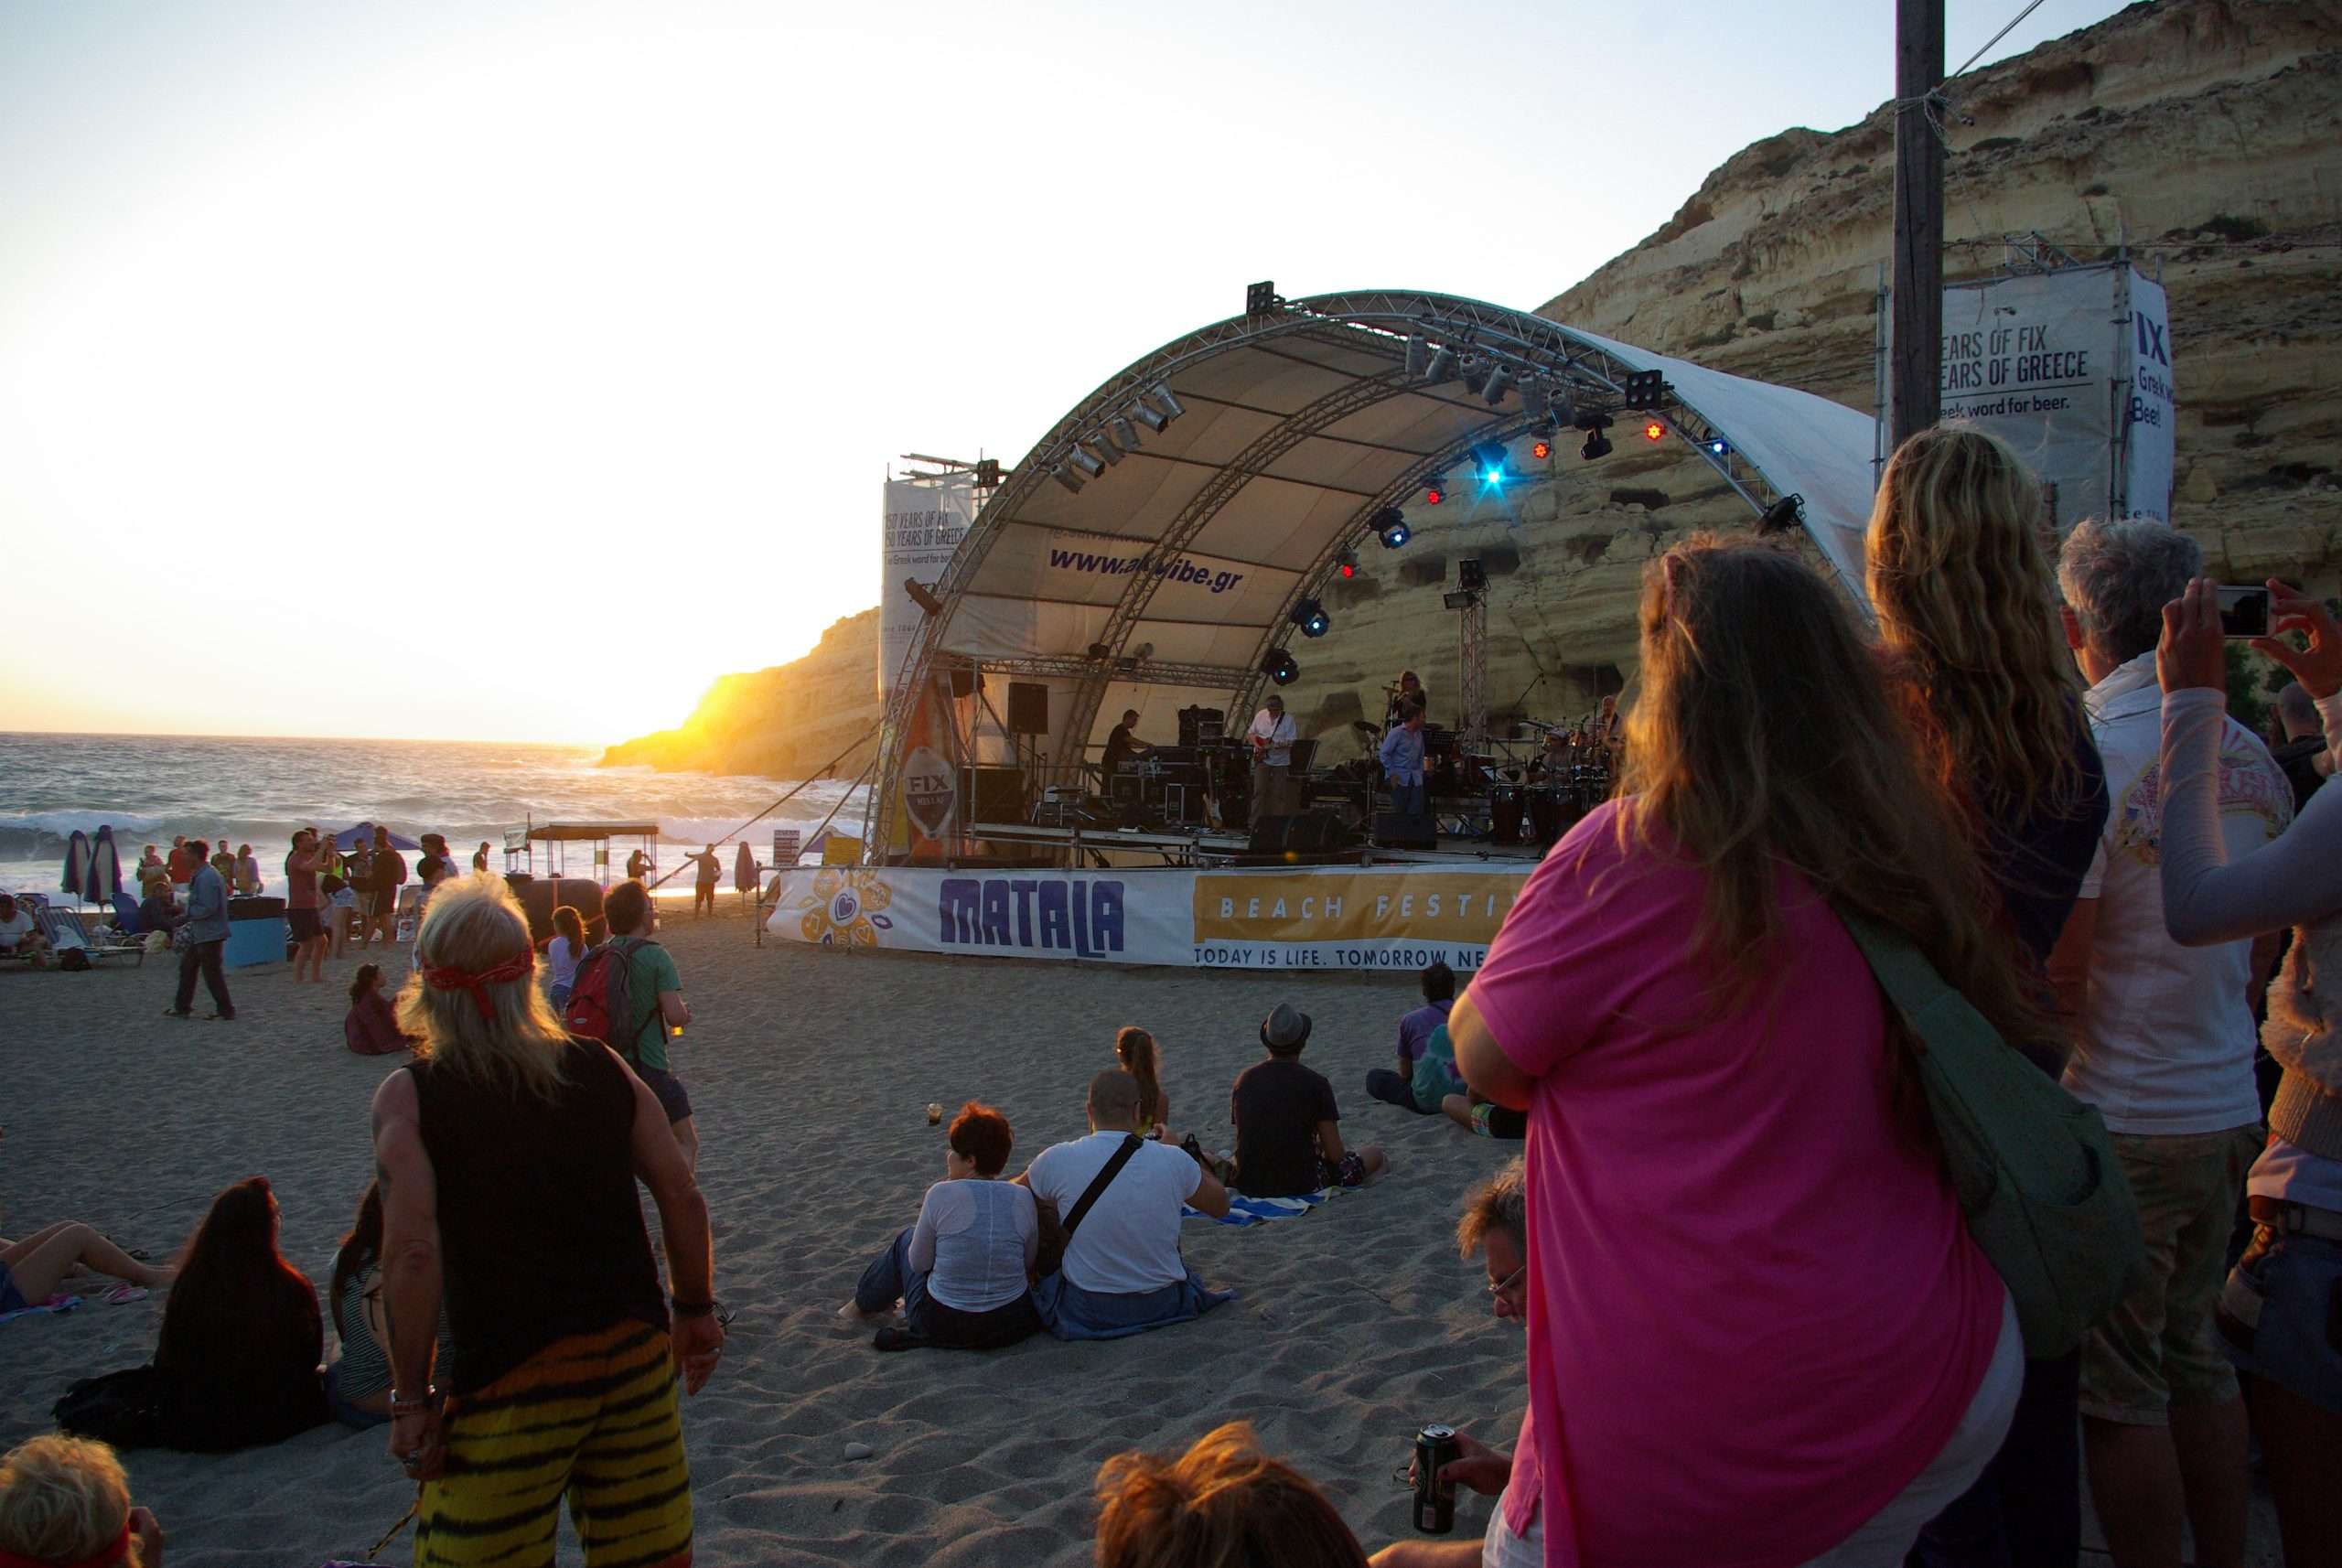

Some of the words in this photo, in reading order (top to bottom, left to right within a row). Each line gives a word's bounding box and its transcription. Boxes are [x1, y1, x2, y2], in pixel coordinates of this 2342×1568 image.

[1940, 332, 1982, 361] EARS
[1990, 328, 2013, 356] OF
[2018, 325, 2048, 352] FIX
[2135, 311, 2168, 366] IX
[1939, 360, 1982, 391] EARS
[1989, 358, 2012, 386] OF
[2017, 351, 2089, 382] GREECE
[1939, 402, 1965, 419] eek
[1968, 397, 2005, 418] word
[2008, 396, 2030, 414] for
[2033, 394, 2070, 413] beer.
[908, 774, 949, 793] FIX
[940, 878, 1125, 959] MATALA
[1219, 896, 1344, 919] BEACH
[1375, 892, 1516, 918] FESTI
[1193, 947, 1252, 966] TODAY
[1260, 948, 1277, 966] IS
[1284, 949, 1327, 966] LIFE.
[1335, 949, 1447, 968] TOMORROW
[1457, 950, 1485, 967] NE
